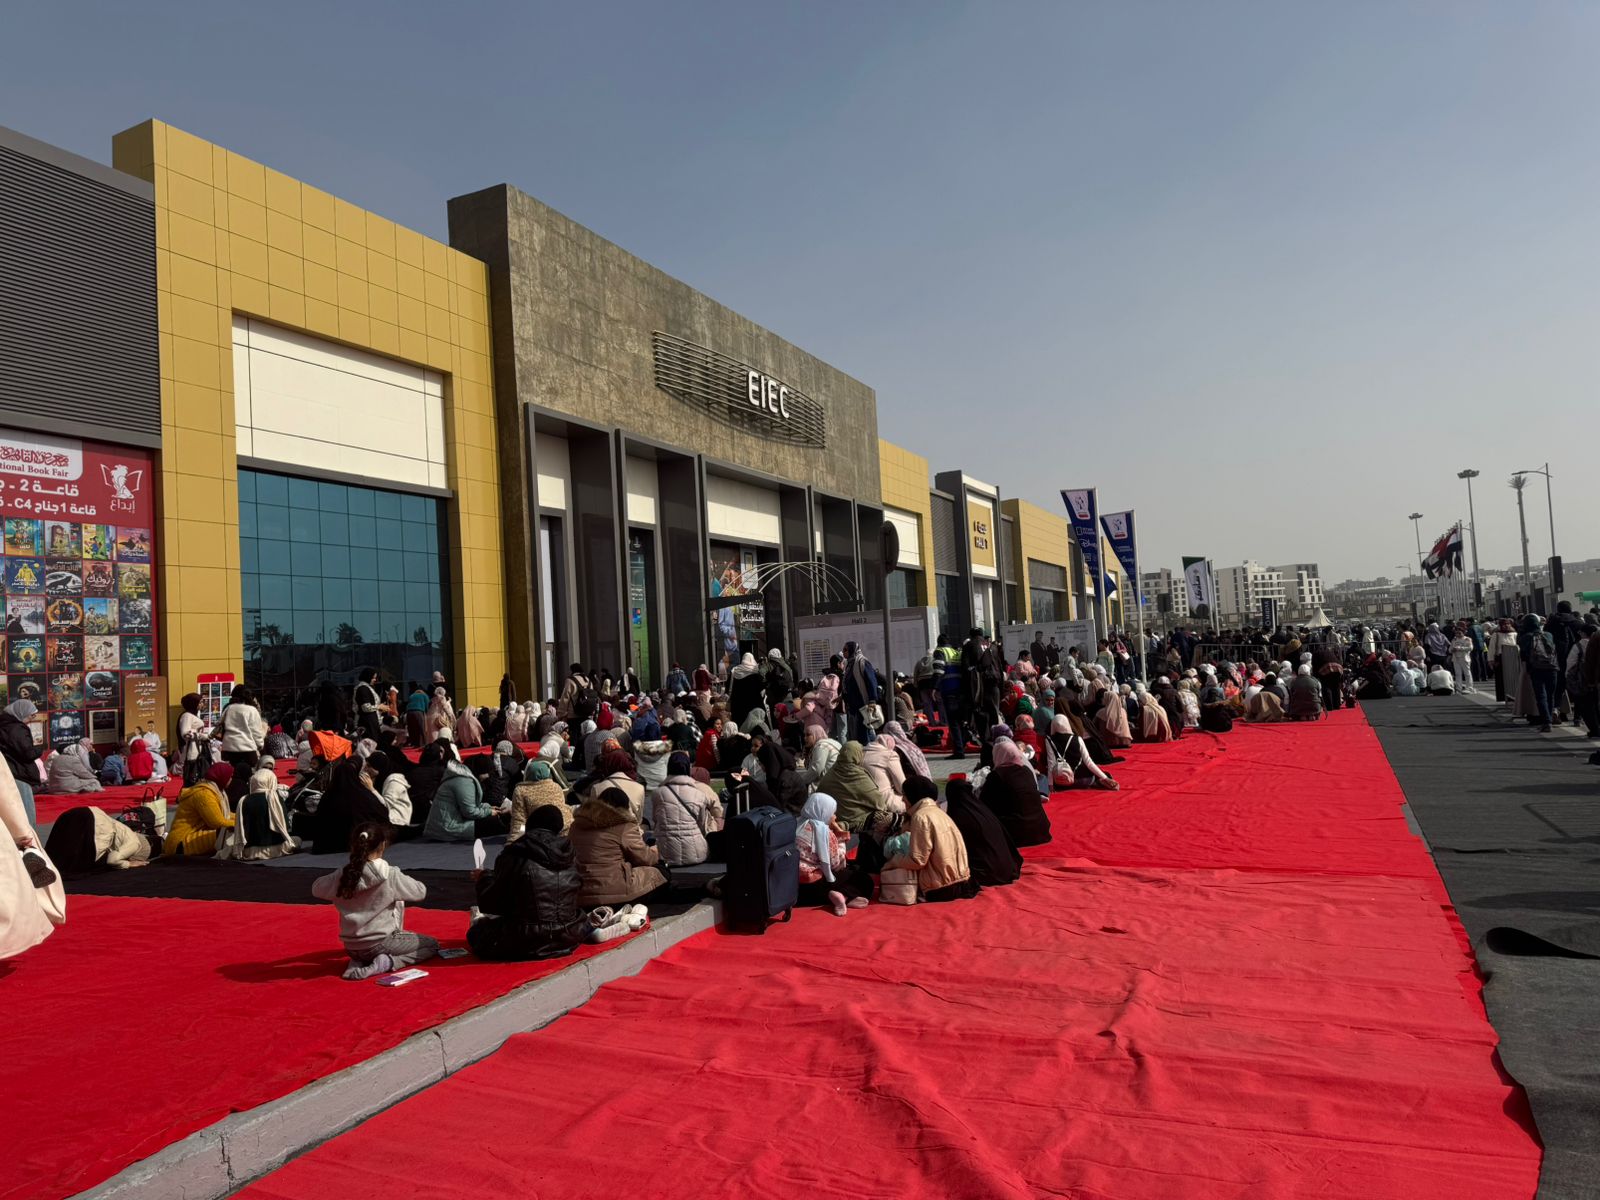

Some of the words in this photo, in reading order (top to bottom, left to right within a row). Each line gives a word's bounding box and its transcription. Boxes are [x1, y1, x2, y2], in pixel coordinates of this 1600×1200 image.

[748, 371, 790, 419] EIEC
[28, 465, 50, 475] Book
[52, 468, 69, 478] Fair
[19, 479, 29, 491] 2
[14, 497, 32, 510] C4
[69, 504, 97, 516] قاعة
